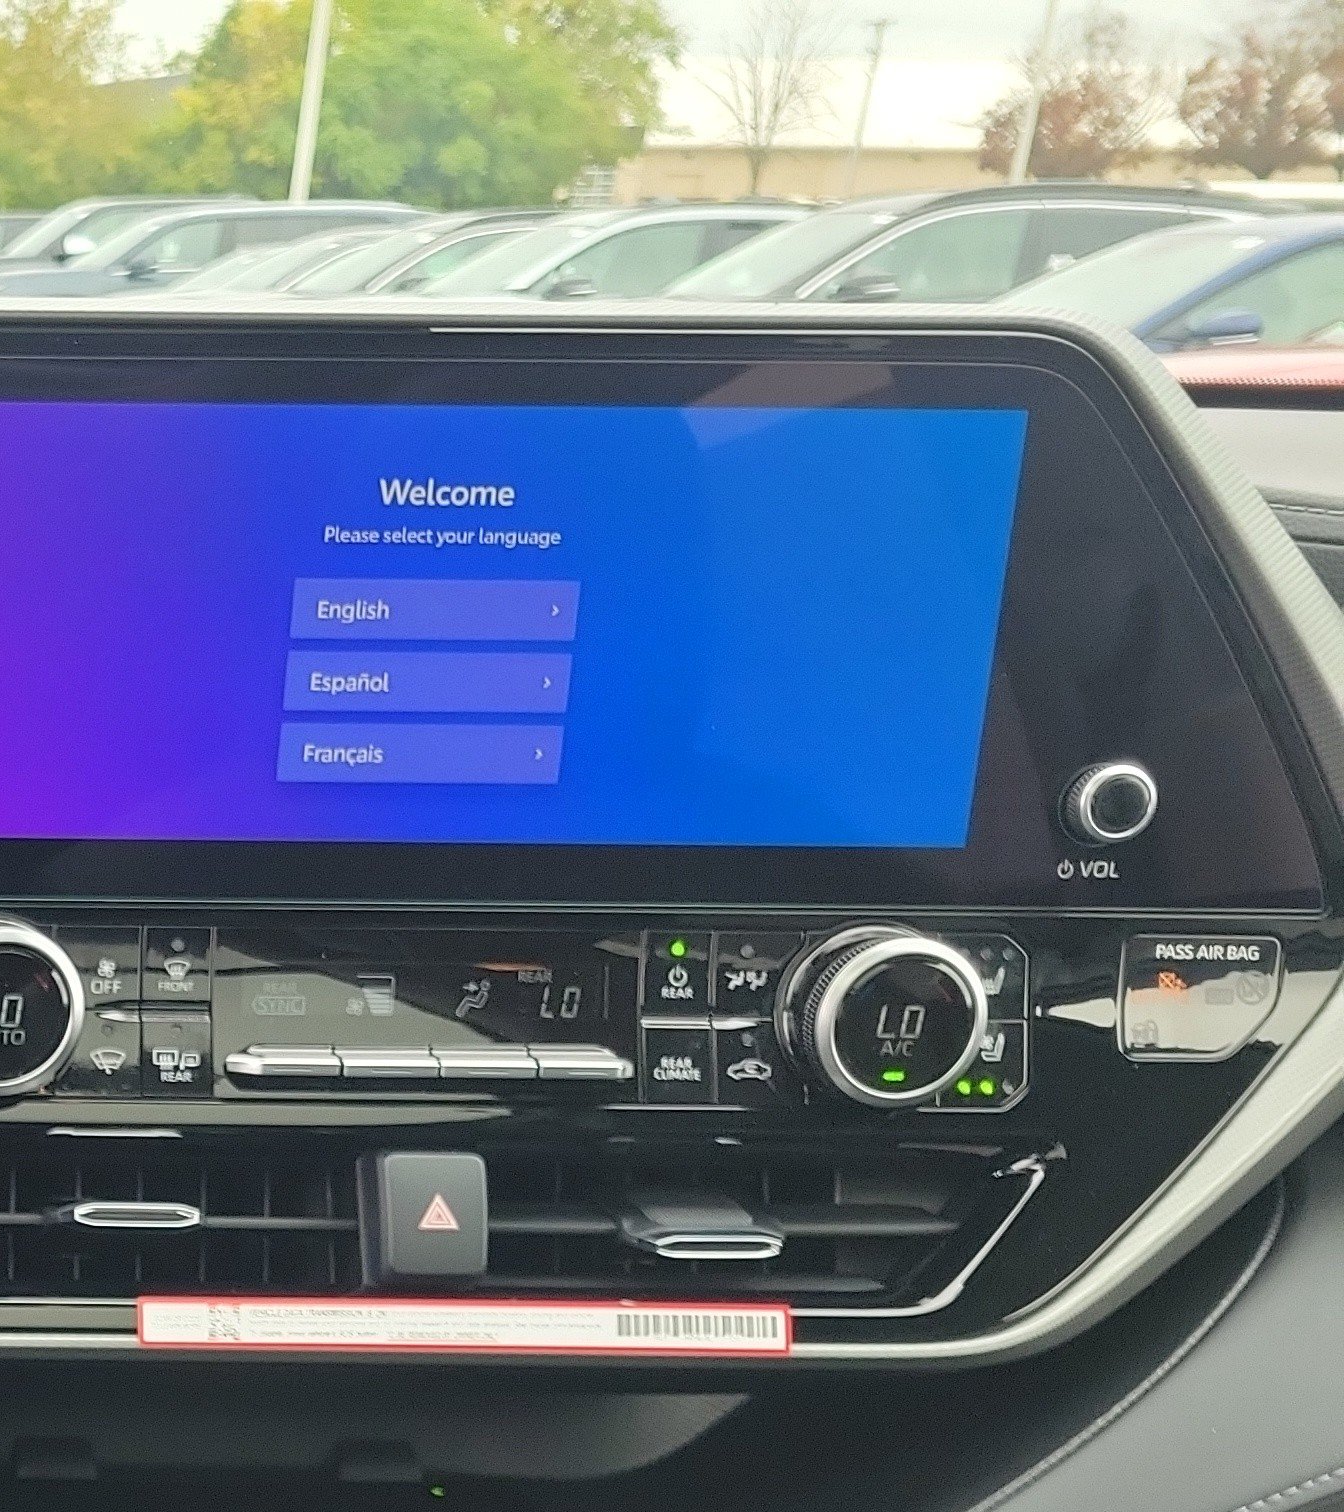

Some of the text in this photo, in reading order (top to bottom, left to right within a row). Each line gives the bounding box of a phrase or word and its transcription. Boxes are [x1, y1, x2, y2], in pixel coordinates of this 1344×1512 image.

[379, 477, 515, 507] Welcome
[323, 525, 562, 549] Please select your language
[316, 599, 390, 624] English
[309, 672, 389, 695] Español
[302, 743, 384, 767] Français
[1079, 860, 1120, 878] VOL
[1155, 943, 1261, 961] PASS AIR BAG
[518, 969, 553, 983] REAR
[90, 980, 123, 995] OFF
[158, 981, 195, 993] FRONT
[660, 987, 694, 1000] REAR
[879, 1042, 914, 1057] A/C
[660, 1056, 693, 1069] REAR
[159, 1070, 196, 1083] REAR
[652, 1068, 703, 1082] CLIMATE
